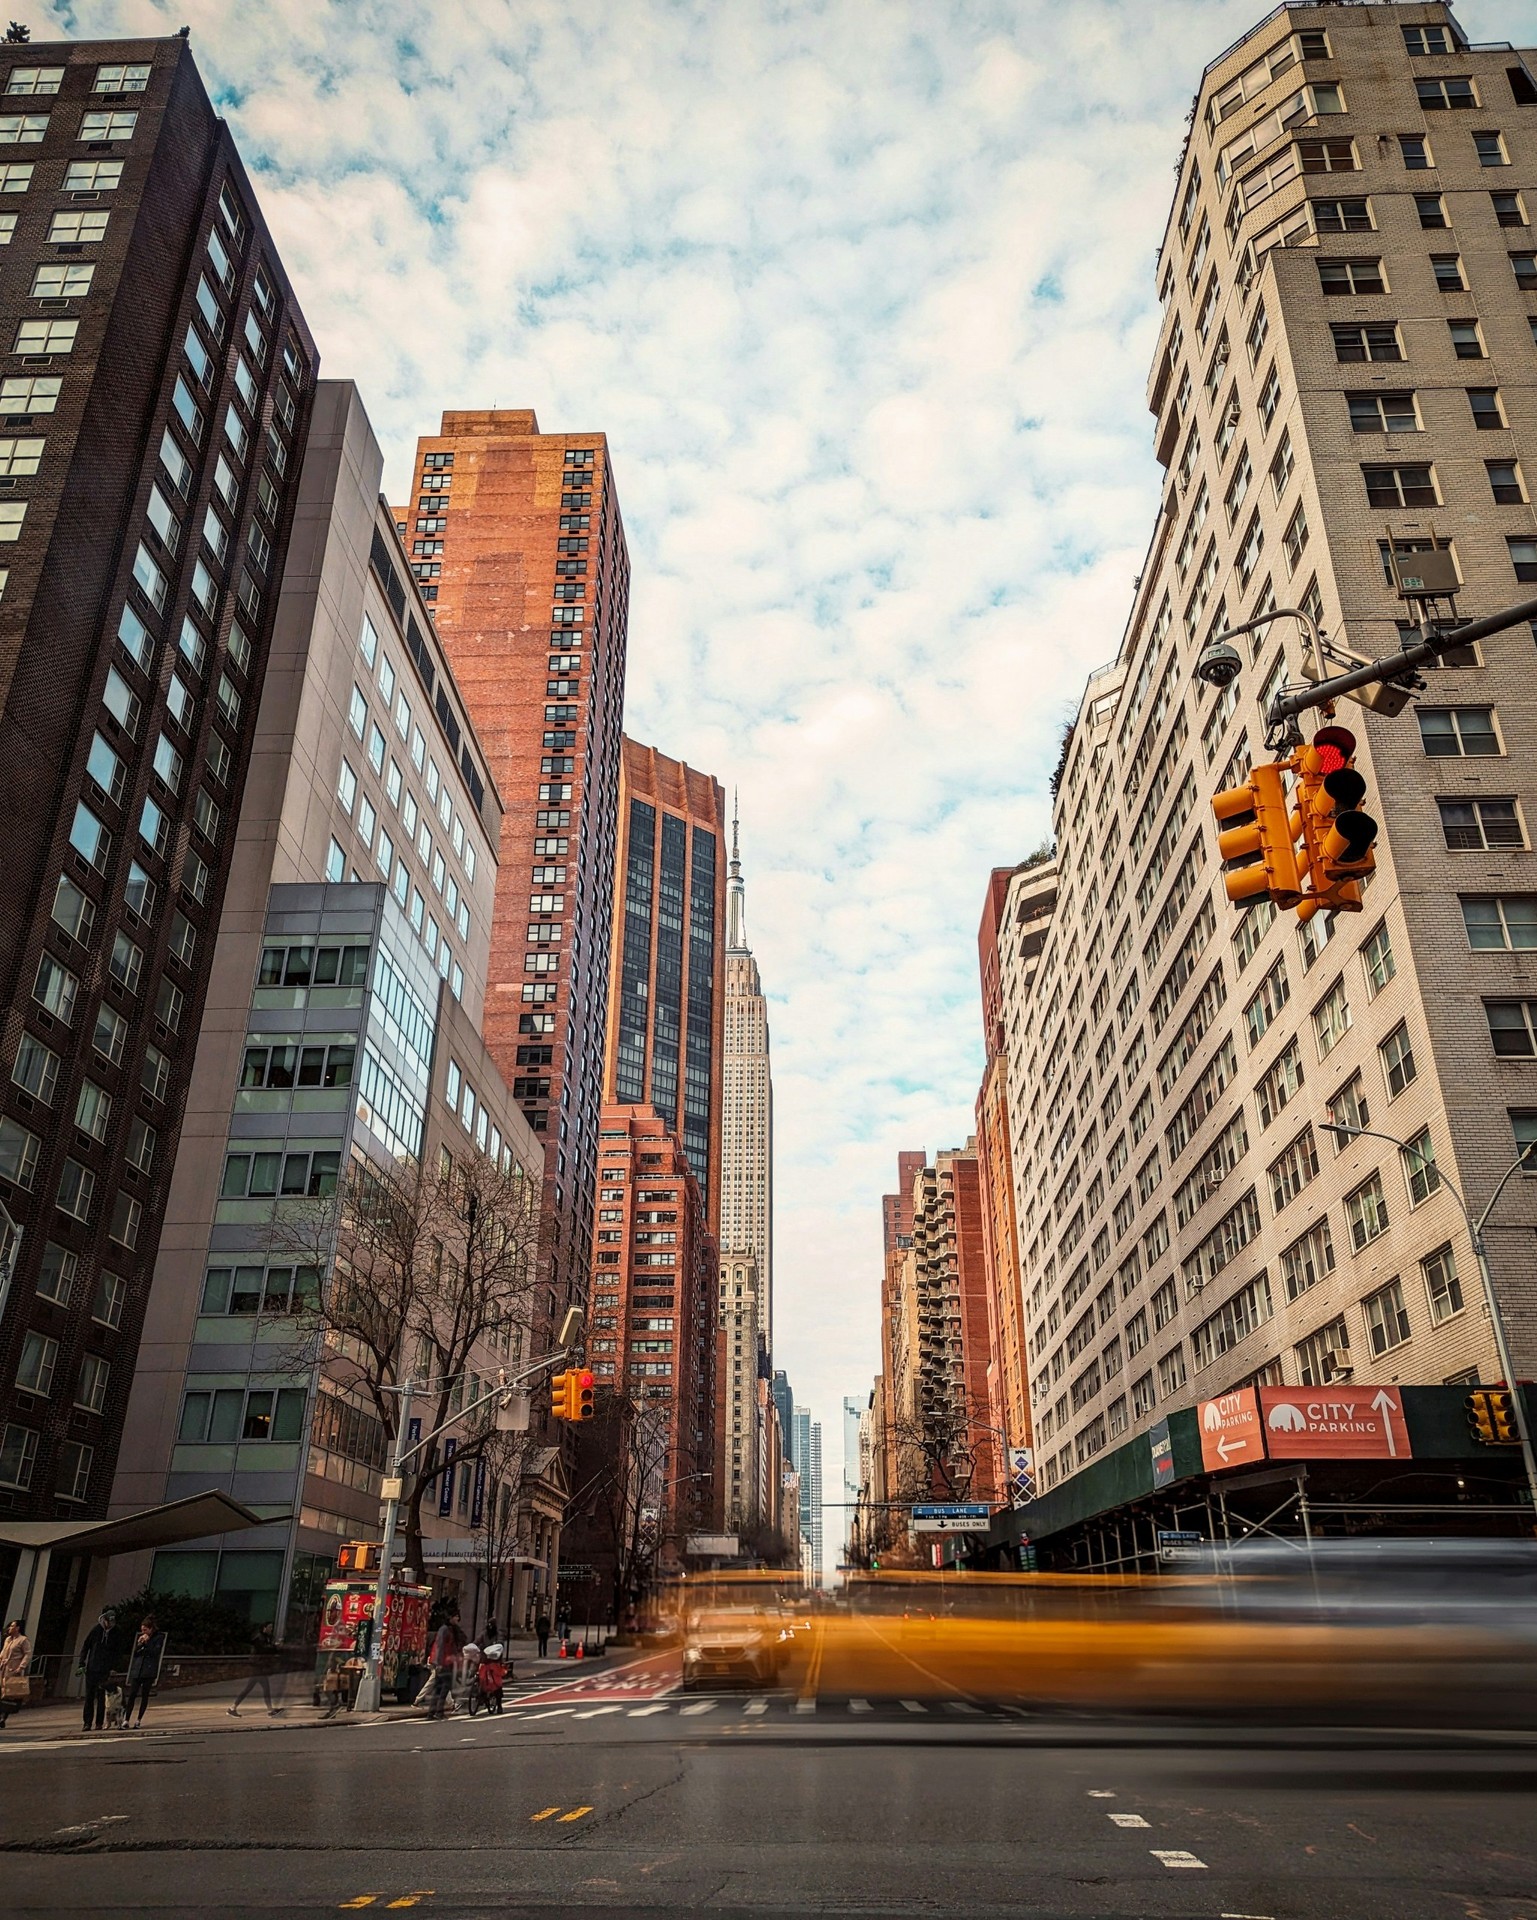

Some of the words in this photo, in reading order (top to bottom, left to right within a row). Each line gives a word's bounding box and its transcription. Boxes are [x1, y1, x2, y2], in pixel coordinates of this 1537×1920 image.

[1219, 1393, 1242, 1416] CITY
[1307, 1403, 1355, 1420] CITY
[1221, 1411, 1253, 1429] PARKING
[1309, 1422, 1376, 1433] PARKING
